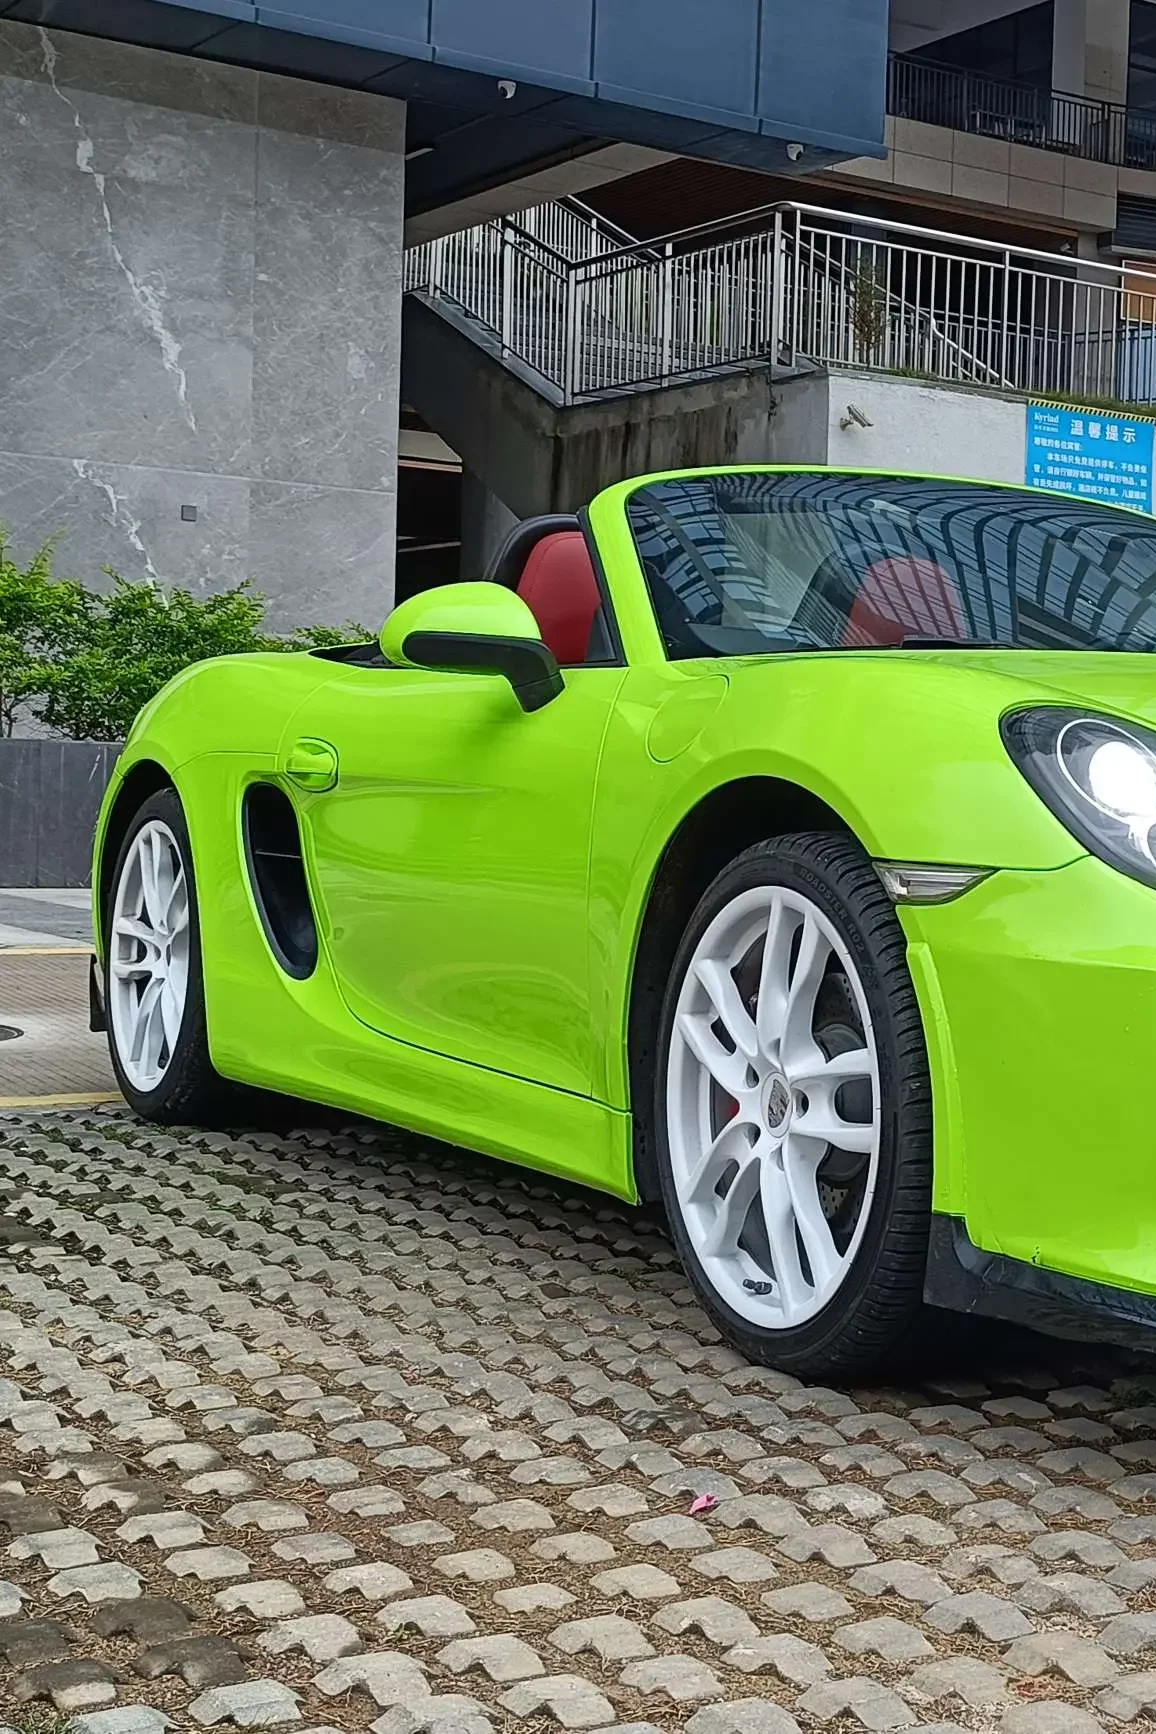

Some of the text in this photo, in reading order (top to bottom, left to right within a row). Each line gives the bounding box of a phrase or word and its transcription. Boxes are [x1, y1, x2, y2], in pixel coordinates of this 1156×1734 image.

[1034, 412, 1059, 424] Kyriad
[1070, 419, 1136, 443] 温馨提示
